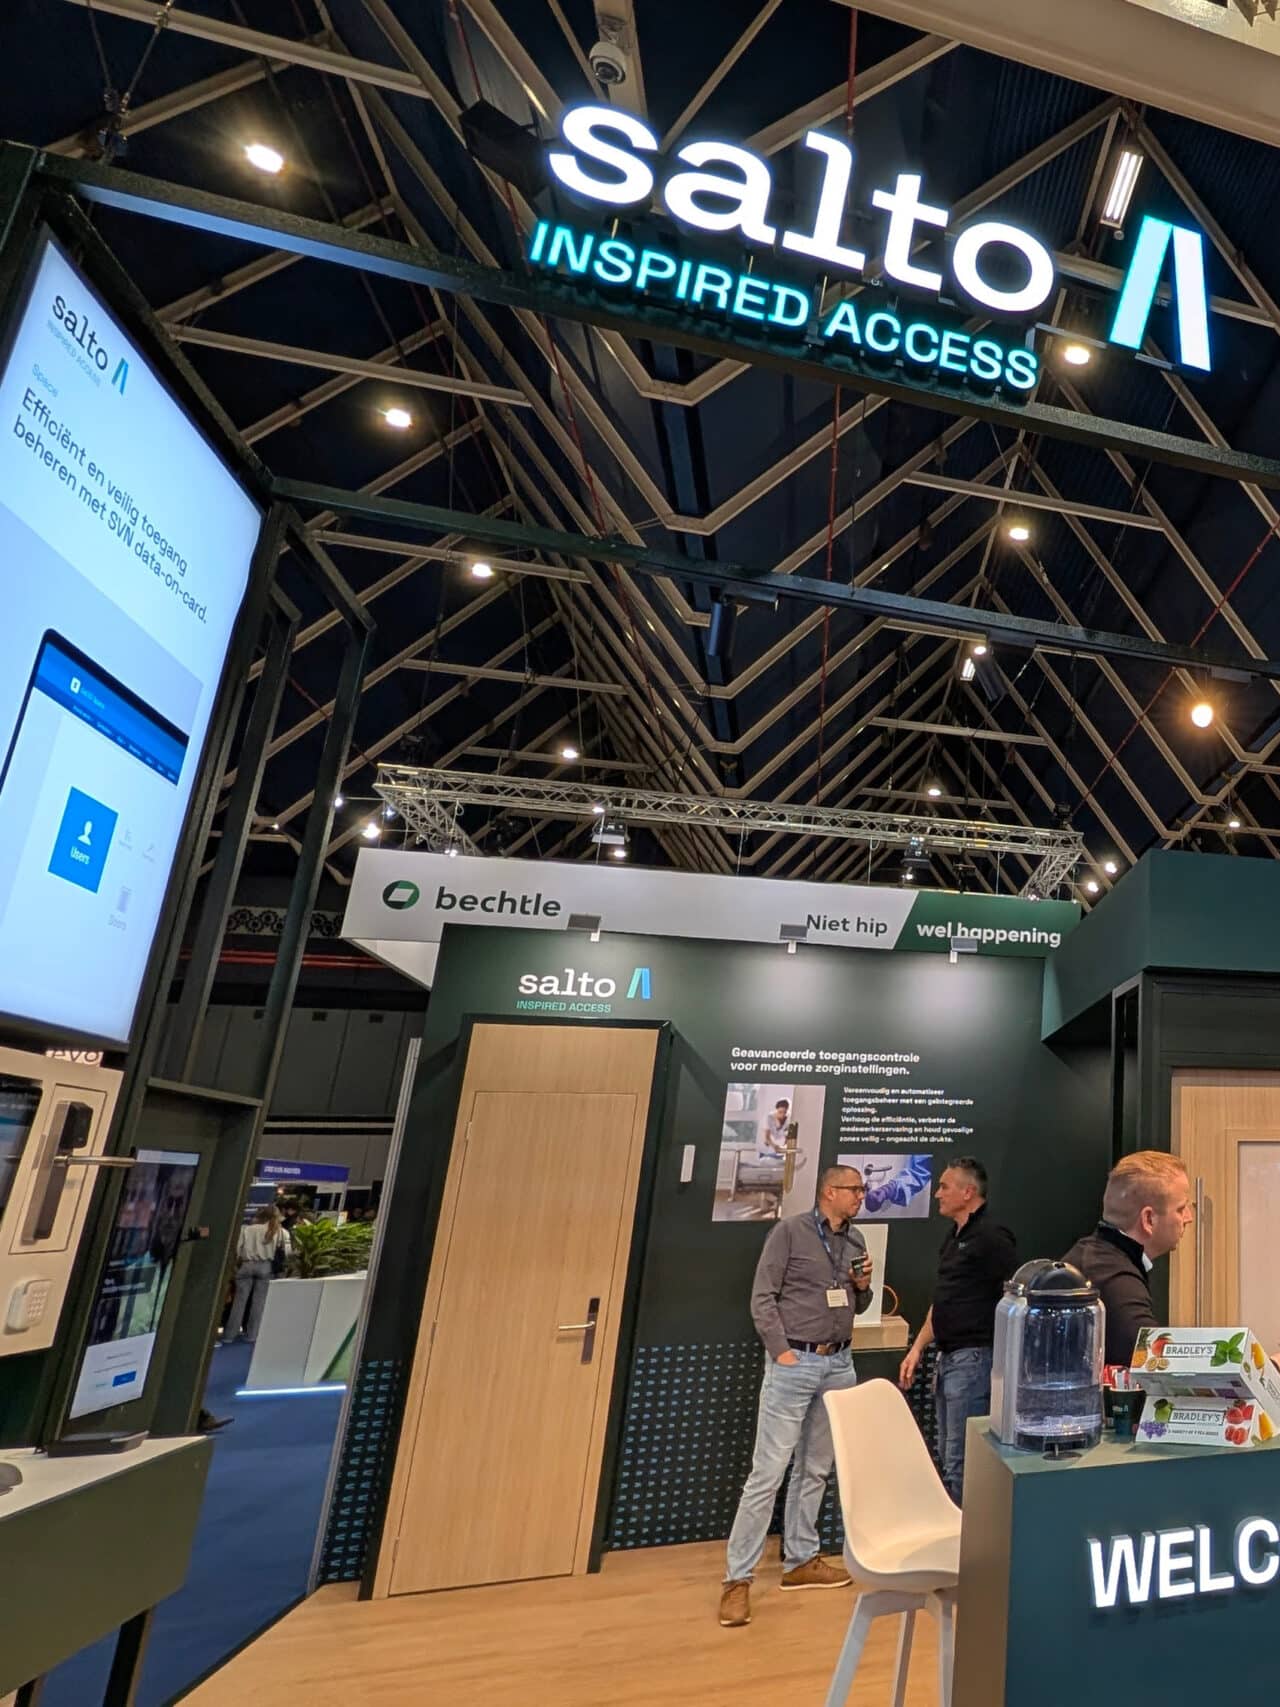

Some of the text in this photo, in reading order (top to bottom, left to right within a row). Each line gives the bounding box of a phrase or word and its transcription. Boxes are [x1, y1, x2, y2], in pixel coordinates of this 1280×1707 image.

[547, 104, 1055, 313] salto
[530, 220, 1039, 390] INSPIRED ACCESS
[52, 295, 108, 371] salto
[22, 387, 188, 577] Efficiënt en veilig toegang
[13, 414, 207, 624] beheren met SVN data-on-card.
[435, 886, 562, 917] bechtle
[806, 914, 1062, 948] Niet hip wel happening
[518, 967, 617, 998] salto
[516, 1000, 612, 1013] INSPIRED ACCESS
[730, 1062, 910, 1077] voor moderne zorginstellingen.
[731, 1047, 920, 1063] Geavanceerde toegangscontrole
[1166, 1345, 1214, 1355] BRADLEY'S
[1172, 1411, 1221, 1422] BRADLEY'S
